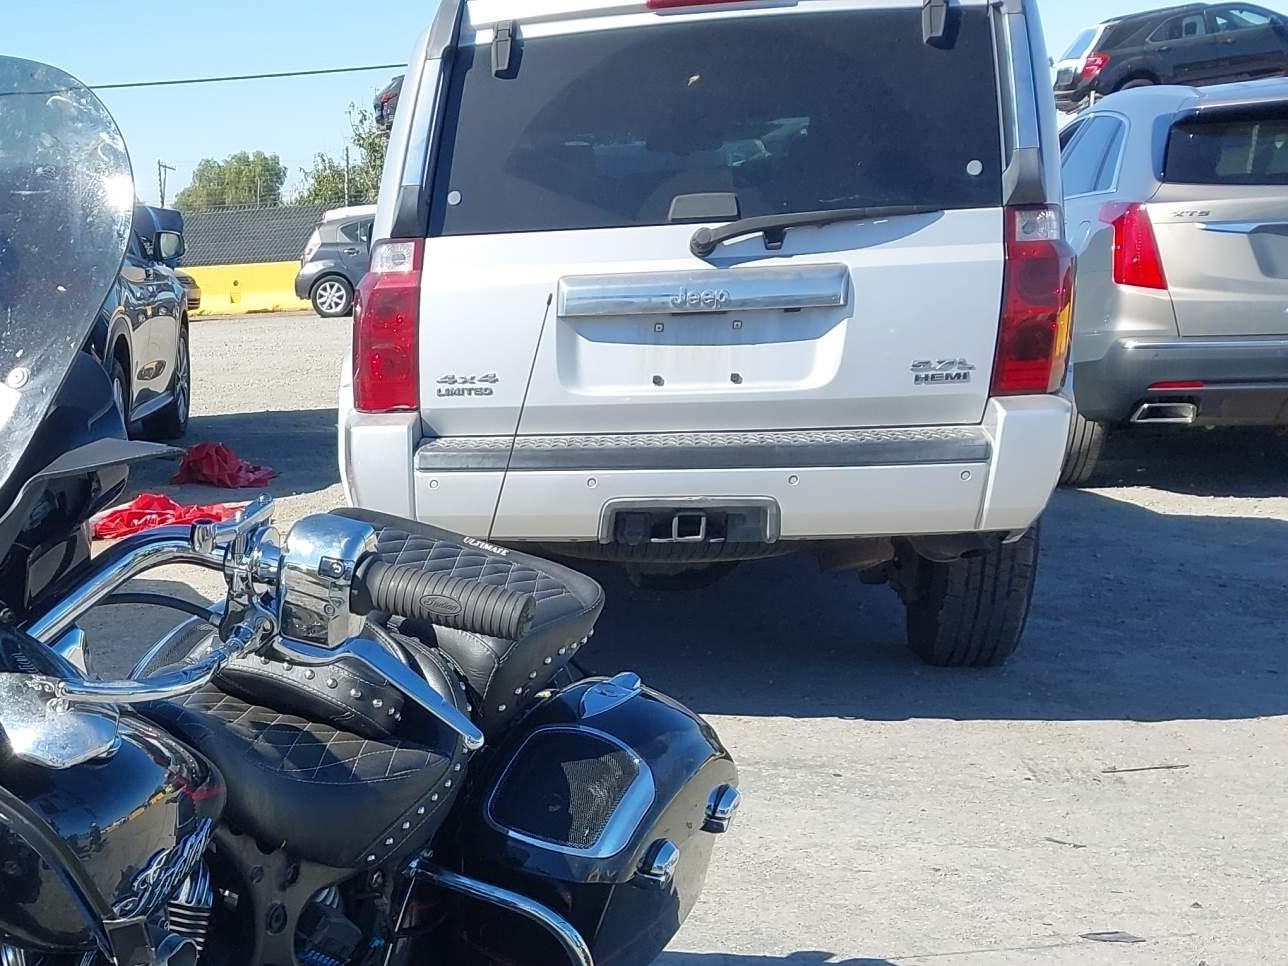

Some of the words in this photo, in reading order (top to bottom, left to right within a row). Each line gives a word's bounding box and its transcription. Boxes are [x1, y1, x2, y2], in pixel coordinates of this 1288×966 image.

[670, 286, 730, 309] Jeep
[436, 373, 499, 385] 4x4
[914, 372, 971, 385] HEMI
[436, 387, 494, 397] LIMITED
[463, 536, 510, 556] ULTIMATE
